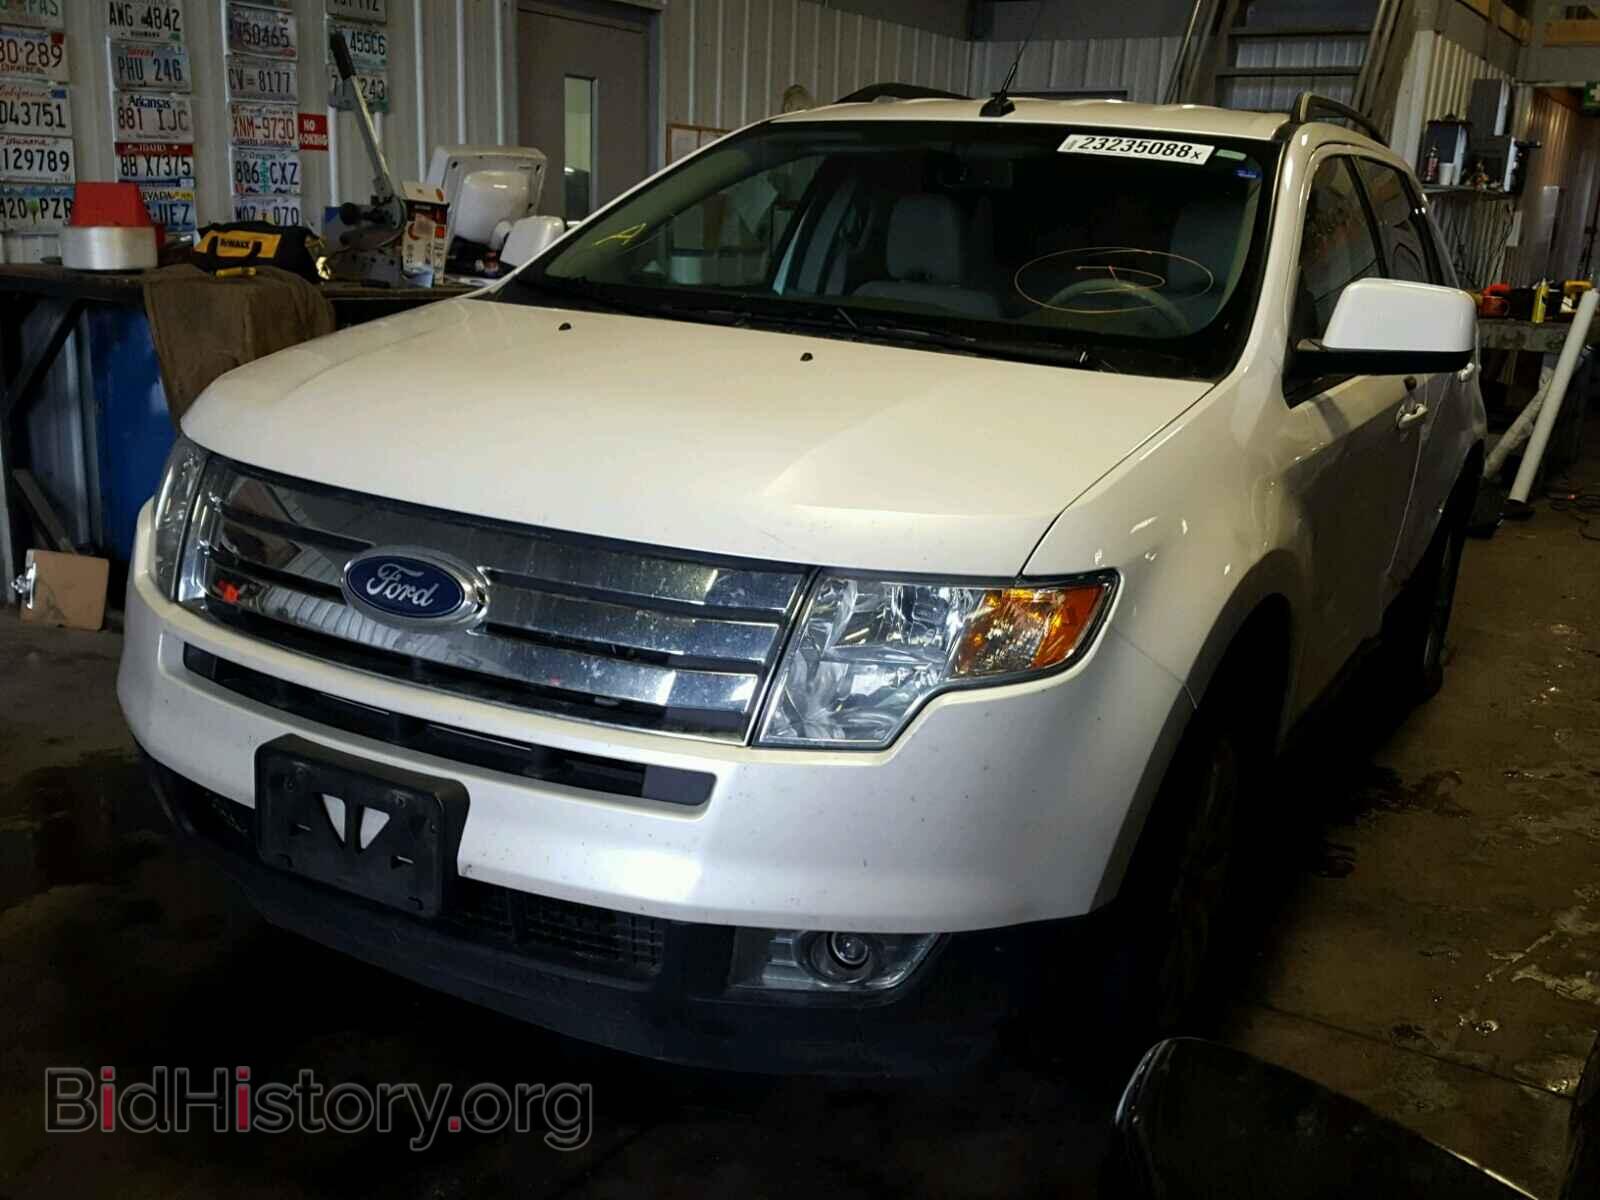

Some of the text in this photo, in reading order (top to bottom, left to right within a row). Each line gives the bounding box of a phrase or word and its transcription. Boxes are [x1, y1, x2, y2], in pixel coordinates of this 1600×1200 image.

[154, 58, 182, 81] 246
[4, 147, 70, 172] 129789
[144, 154, 191, 177] X7375
[270, 162, 299, 185] CXZ
[366, 563, 440, 608] Ford
